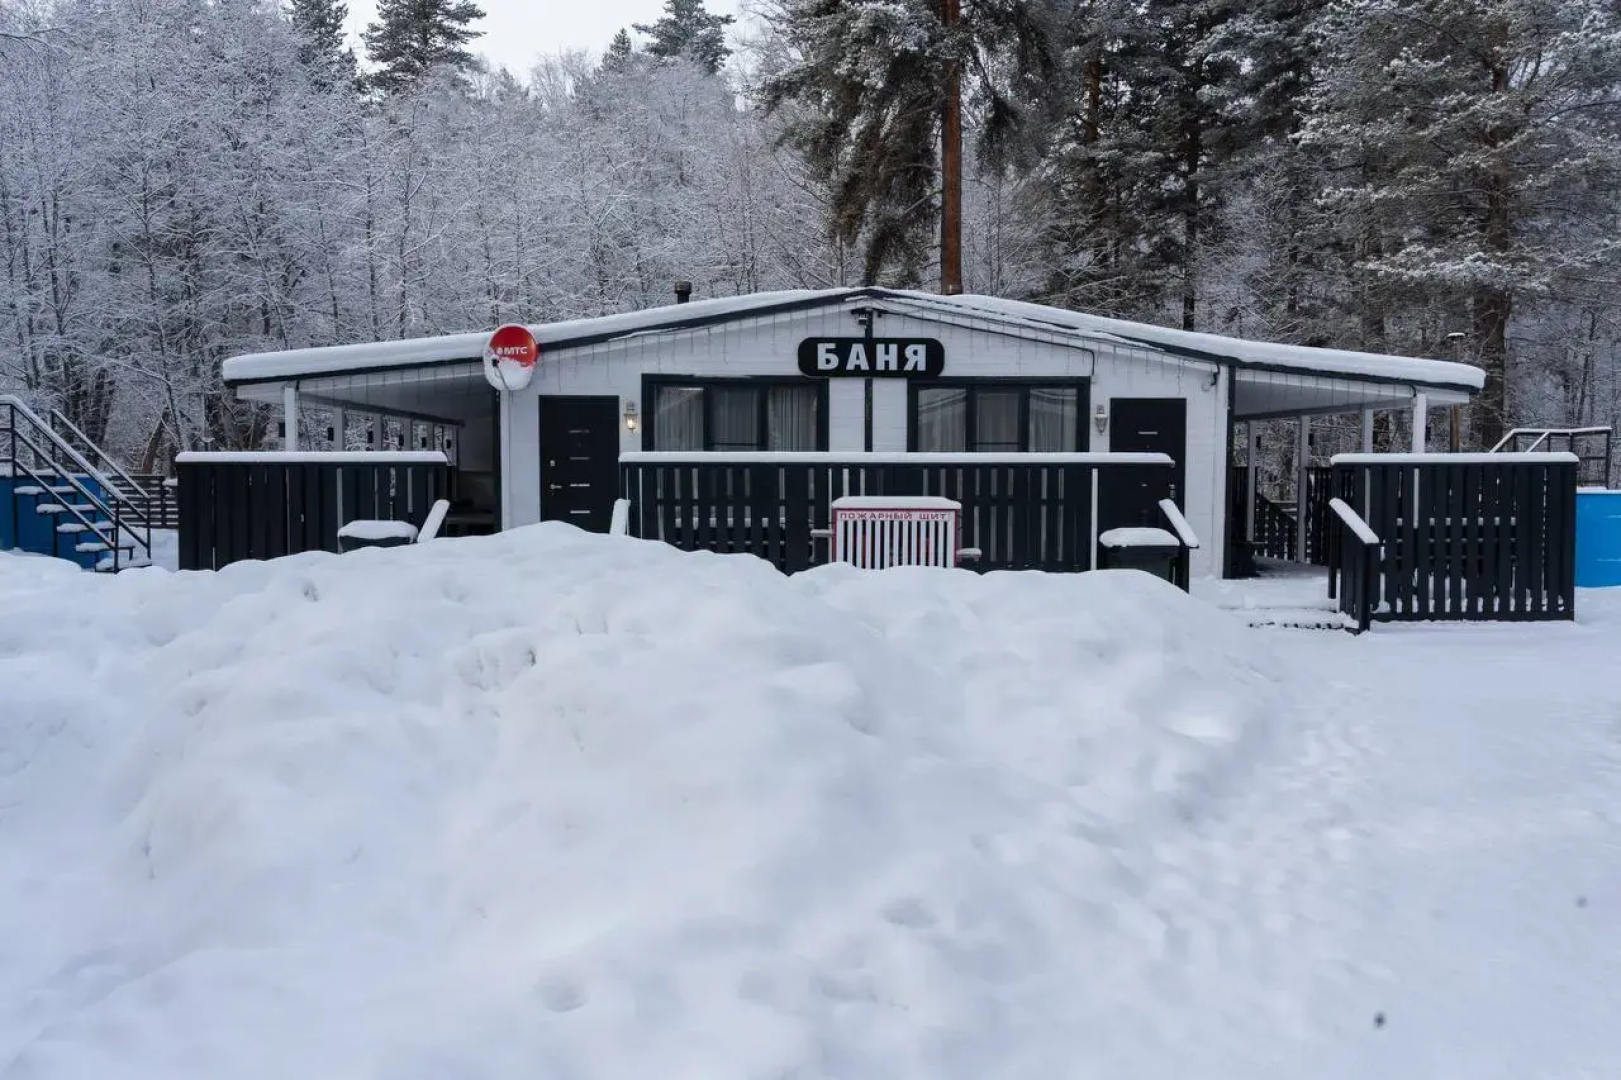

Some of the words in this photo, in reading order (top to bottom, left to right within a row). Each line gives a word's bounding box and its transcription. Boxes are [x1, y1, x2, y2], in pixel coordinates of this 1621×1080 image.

[504, 346, 528, 355] МТС
[817, 342, 927, 371] БАНЯ
[840, 512, 913, 520] ПОЖАРНЫЙ
